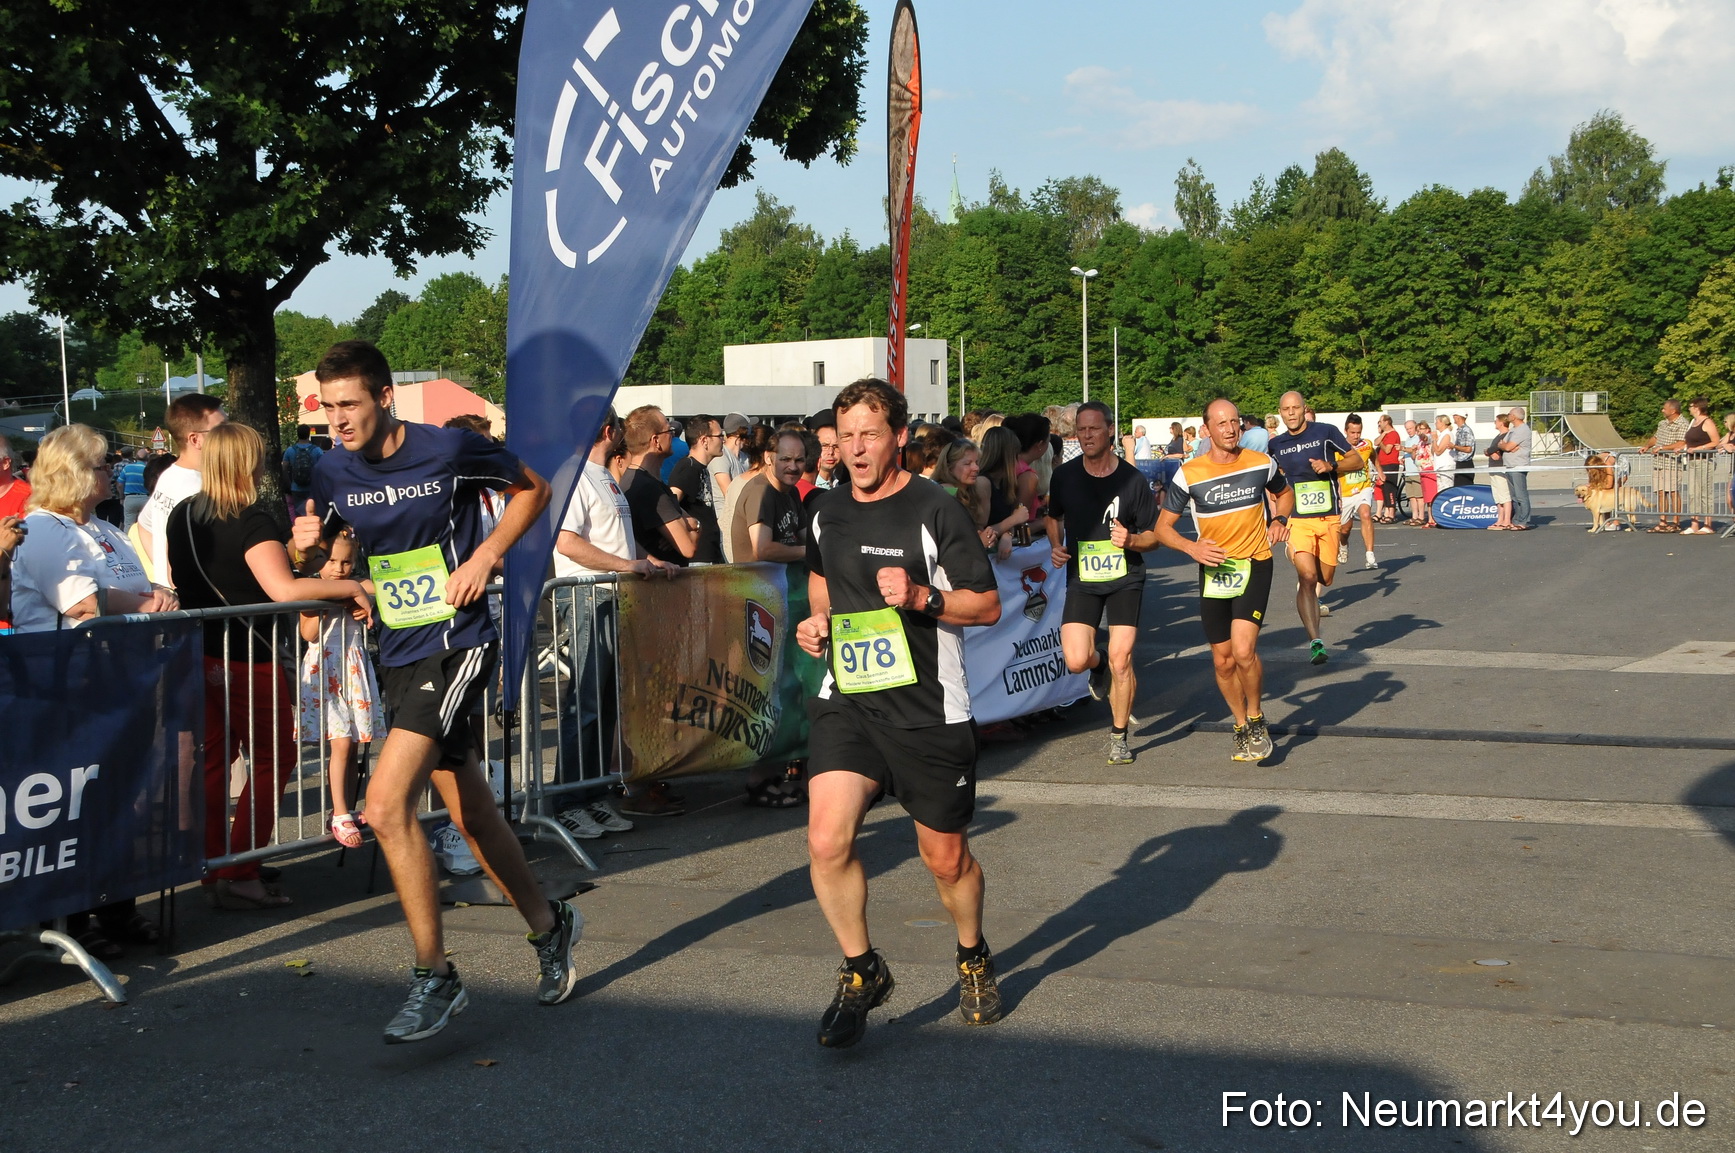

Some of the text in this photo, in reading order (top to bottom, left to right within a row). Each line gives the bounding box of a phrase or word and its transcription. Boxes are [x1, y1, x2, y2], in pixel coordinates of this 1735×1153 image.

[650, 0, 755, 194] AUTOMO
[1280, 440, 1321, 456] EURO POLES
[347, 480, 441, 507] EURO POLES
[1214, 486, 1257, 502] Fischer
[1219, 494, 1255, 506] AUTOMOBILE
[1301, 491, 1326, 506] 328
[1081, 554, 1123, 571] 1047
[1212, 571, 1244, 589] 402
[382, 574, 441, 610] 332
[841, 637, 896, 674] 978
[1003, 652, 1073, 696] Lammsbr
[0, 838, 78, 884] BILE
